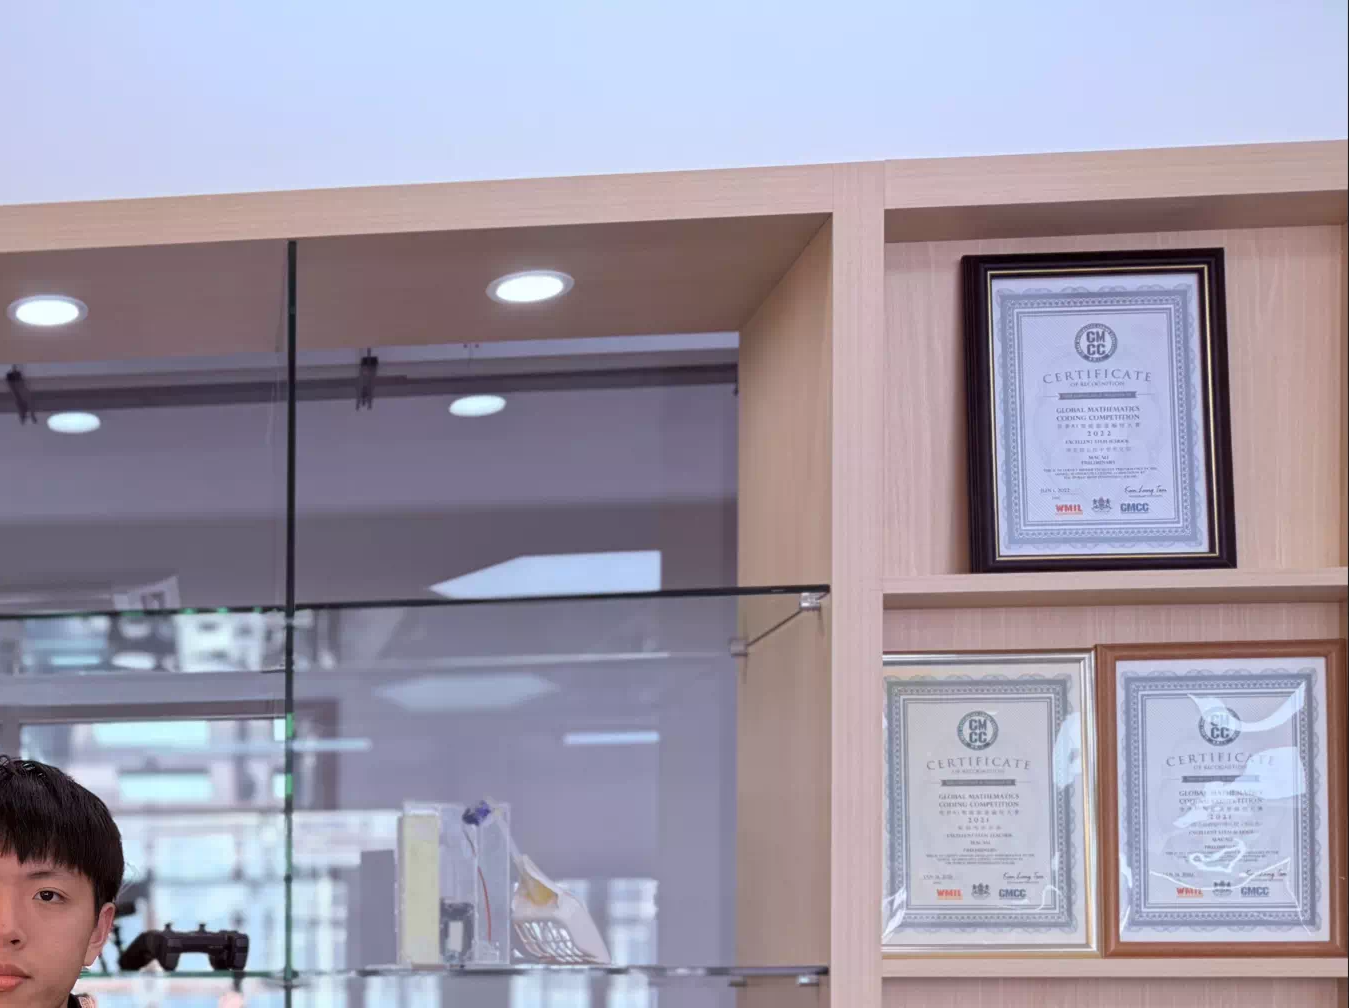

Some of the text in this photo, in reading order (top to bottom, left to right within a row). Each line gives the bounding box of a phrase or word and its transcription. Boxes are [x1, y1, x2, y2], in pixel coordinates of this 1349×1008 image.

[1042, 368, 1152, 384] CERTIFICATE
[1087, 405, 1140, 414] MATHEMATICS
[1088, 414, 1140, 422] COMPETITION
[926, 756, 1031, 770] CERTIFICATE
